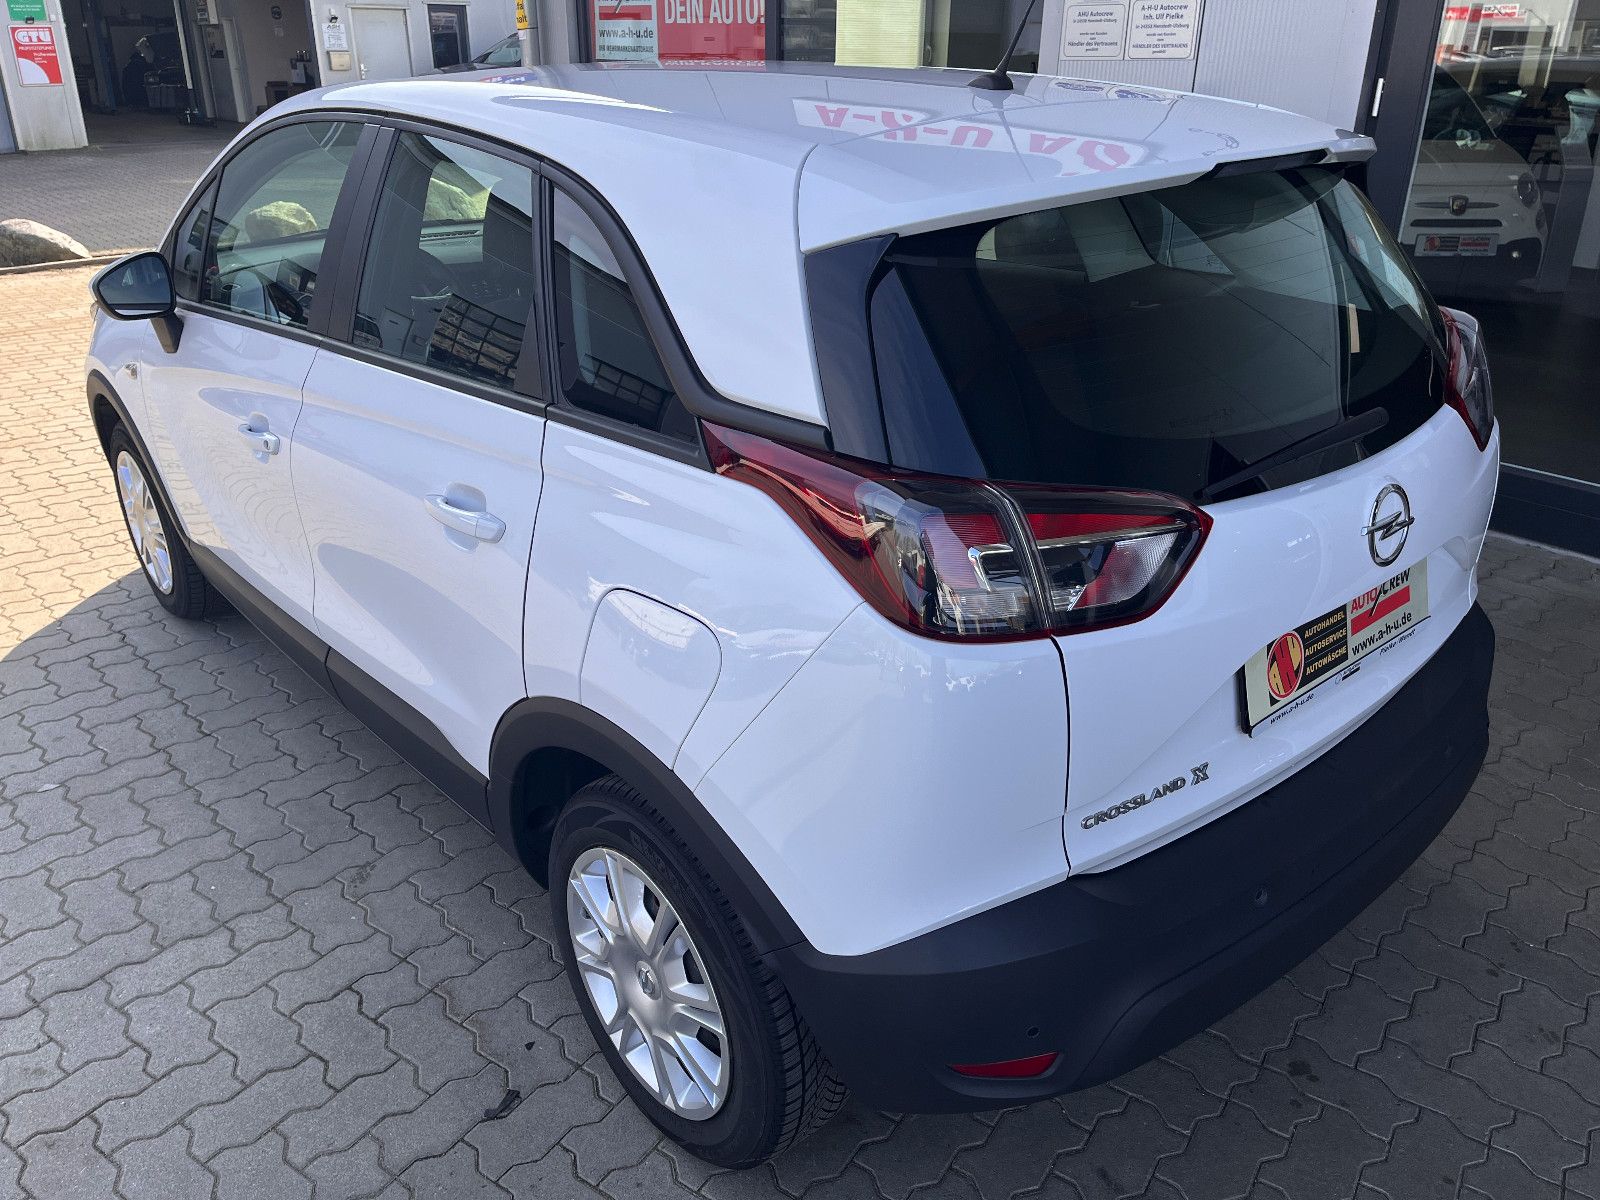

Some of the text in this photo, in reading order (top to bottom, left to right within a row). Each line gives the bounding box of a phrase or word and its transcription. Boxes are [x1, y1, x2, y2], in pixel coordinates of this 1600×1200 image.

[664, 0, 766, 25] DEIN AUTO!
[599, 26, 654, 39] www.a-h-u.de
[1304, 611, 1345, 639] AUTOHANDEL
[1351, 611, 1413, 656] www.a-h-u.de
[1305, 627, 1348, 658] AUTOSERVICE
[1305, 644, 1347, 676] AUTOWÄSCHE
[1081, 761, 1210, 830] CROSSLAND X
